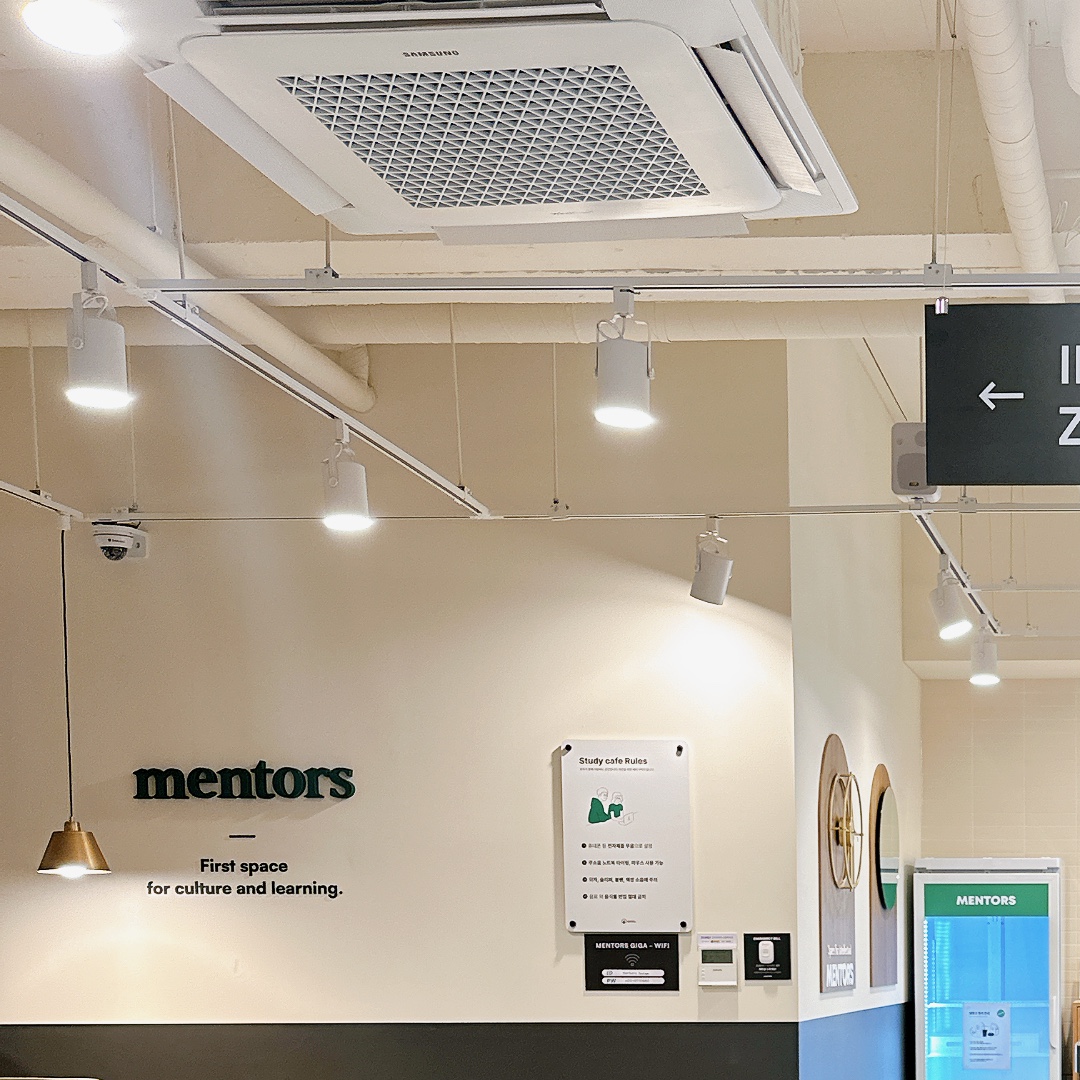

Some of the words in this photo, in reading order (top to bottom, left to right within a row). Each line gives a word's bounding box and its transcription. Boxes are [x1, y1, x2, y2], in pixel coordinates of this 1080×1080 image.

[402, 50, 460, 58] SAMSUNG
[579, 757, 604, 766] Study
[605, 757, 623, 765] cafe
[624, 757, 648, 765] Rules
[132, 760, 356, 800] mentors
[200, 859, 236, 873] First
[240, 861, 289, 877] space
[147, 881, 170, 895] for
[174, 881, 232, 895] culture
[236, 881, 267, 895] and
[271, 881, 344, 899] learning.
[955, 895, 1017, 906] MENTORS
